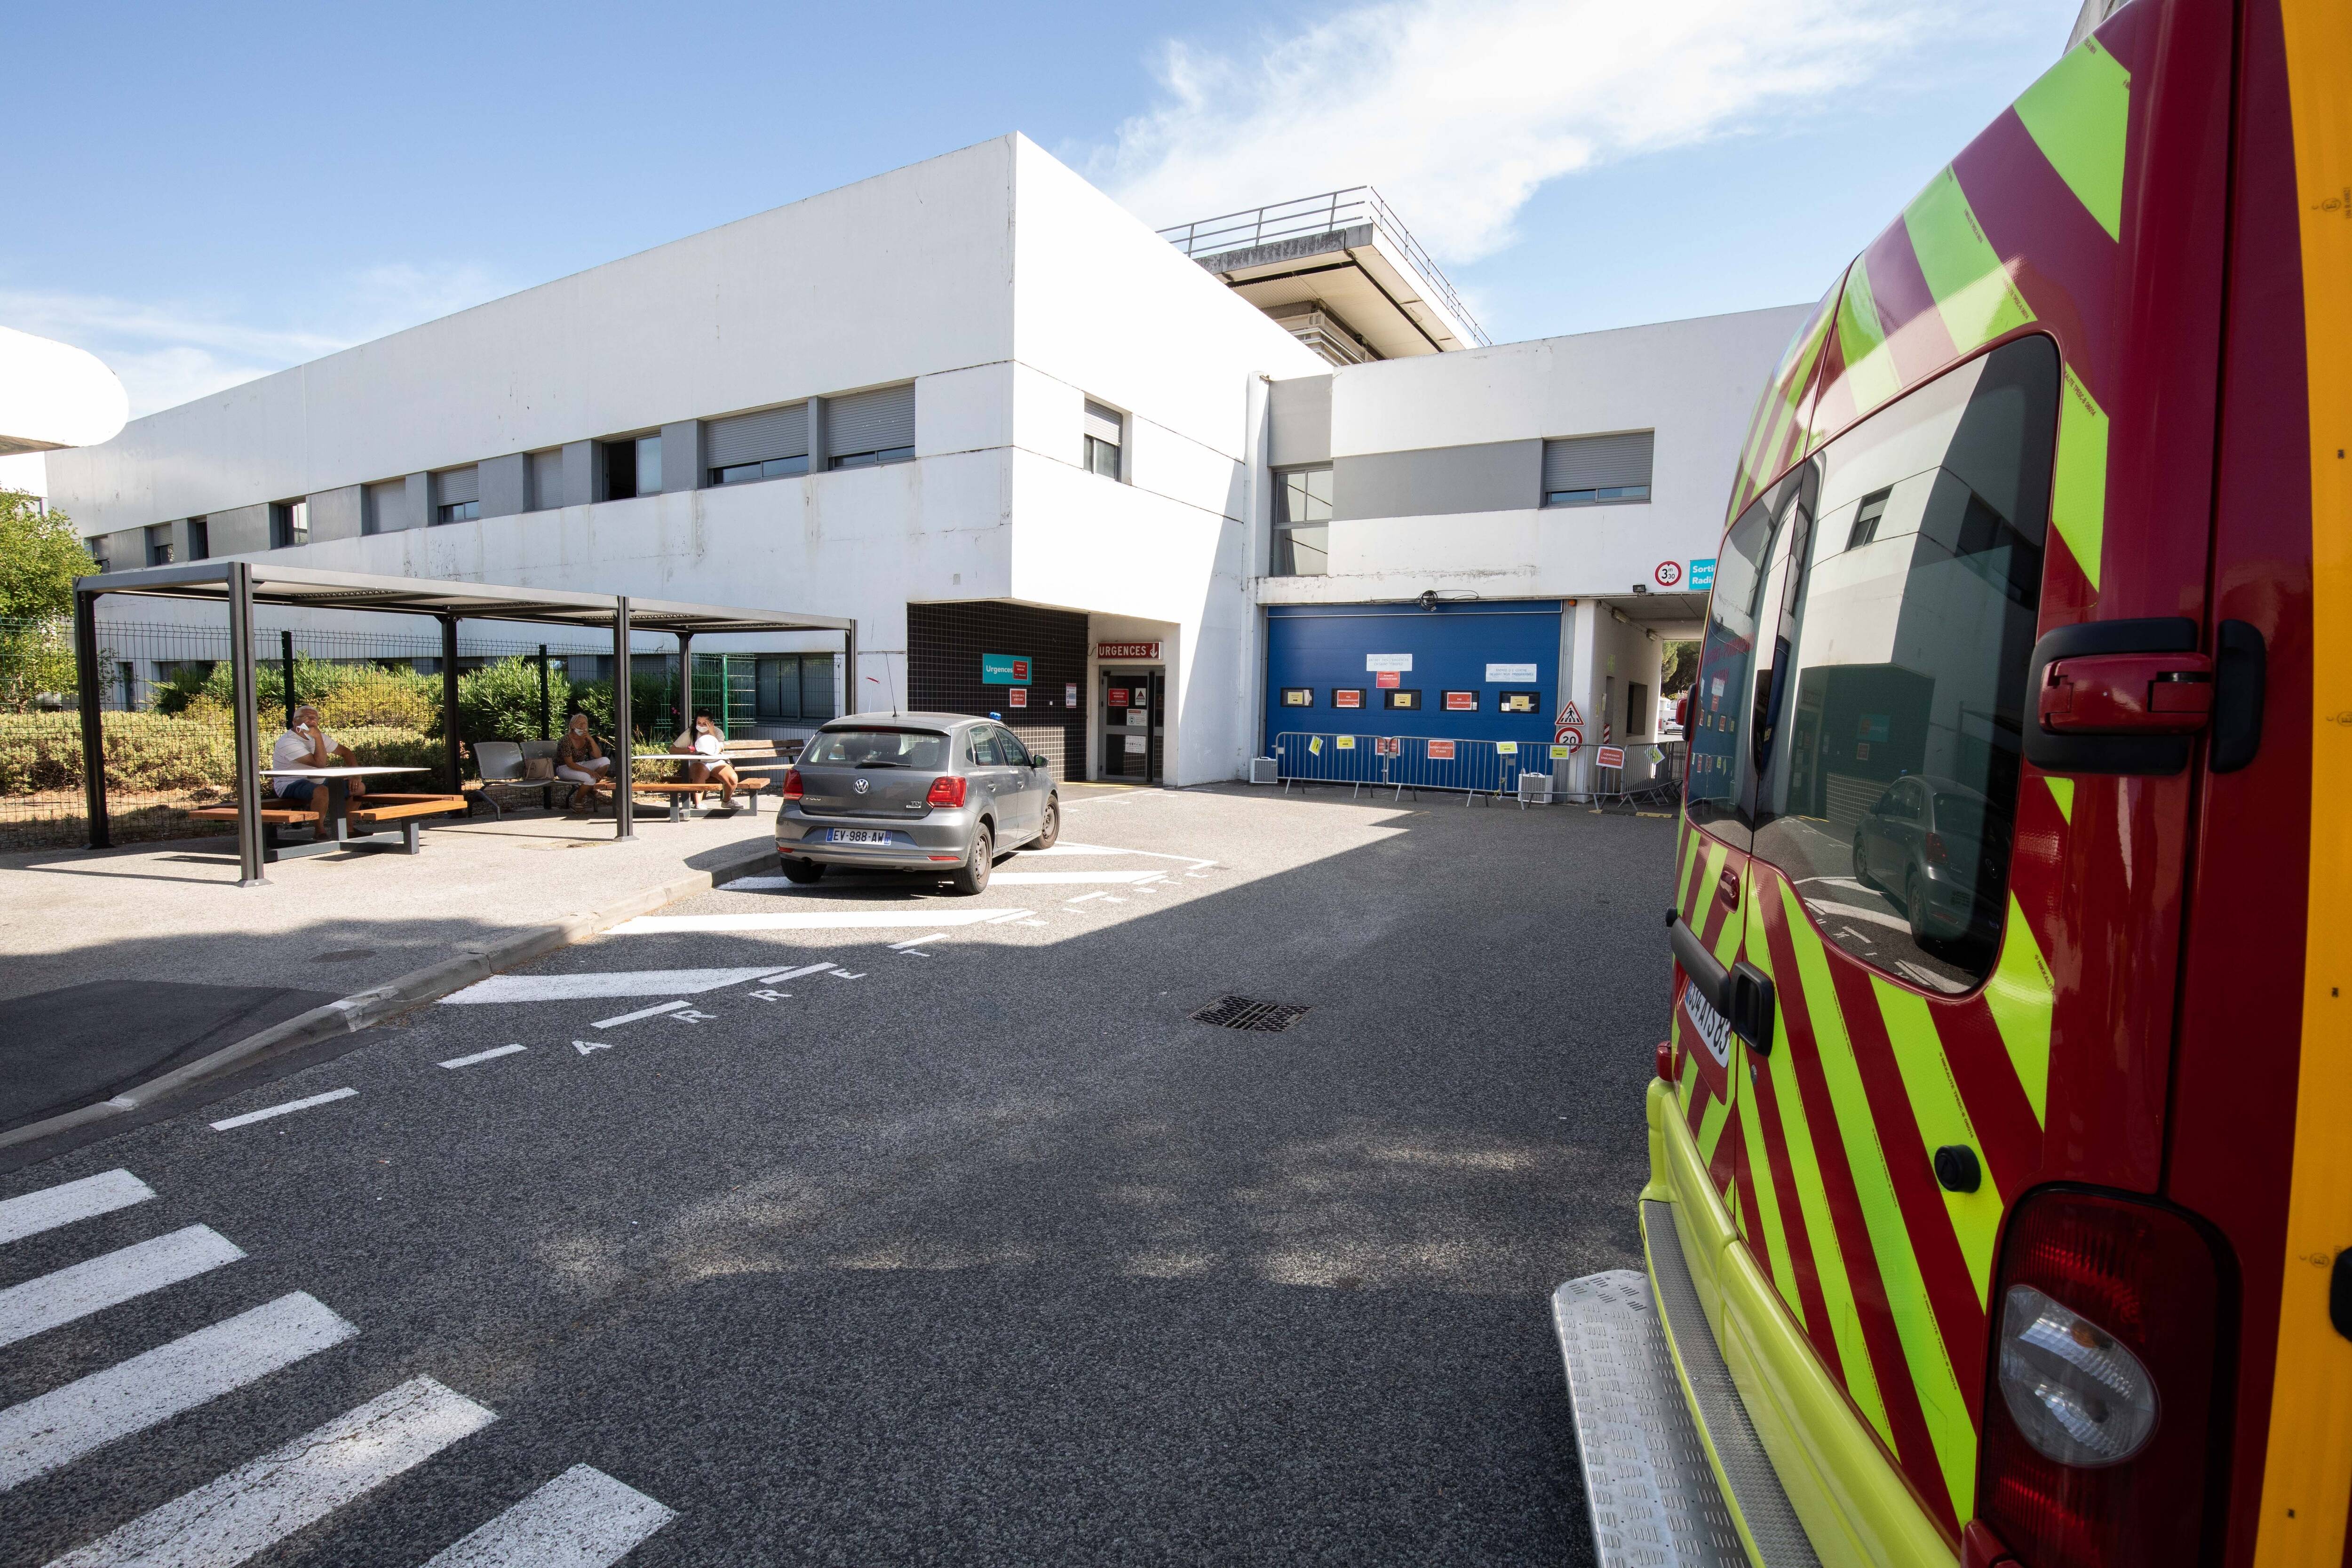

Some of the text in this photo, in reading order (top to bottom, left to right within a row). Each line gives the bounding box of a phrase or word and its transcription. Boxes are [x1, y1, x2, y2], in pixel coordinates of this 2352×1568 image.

[1661, 568, 1668, 579] 3
[1099, 645, 1146, 656] URGENCES
[986, 665, 1013, 674] Urgences
[834, 830, 884, 843] EV-988-AW
[1940, 1057, 1955, 1090] NIKKALITE
[1953, 1090, 1966, 1117] TPESC-B
[1924, 1299, 1938, 1335] NIKKALITE
[1937, 1337, 1949, 1367] TPESC-B
